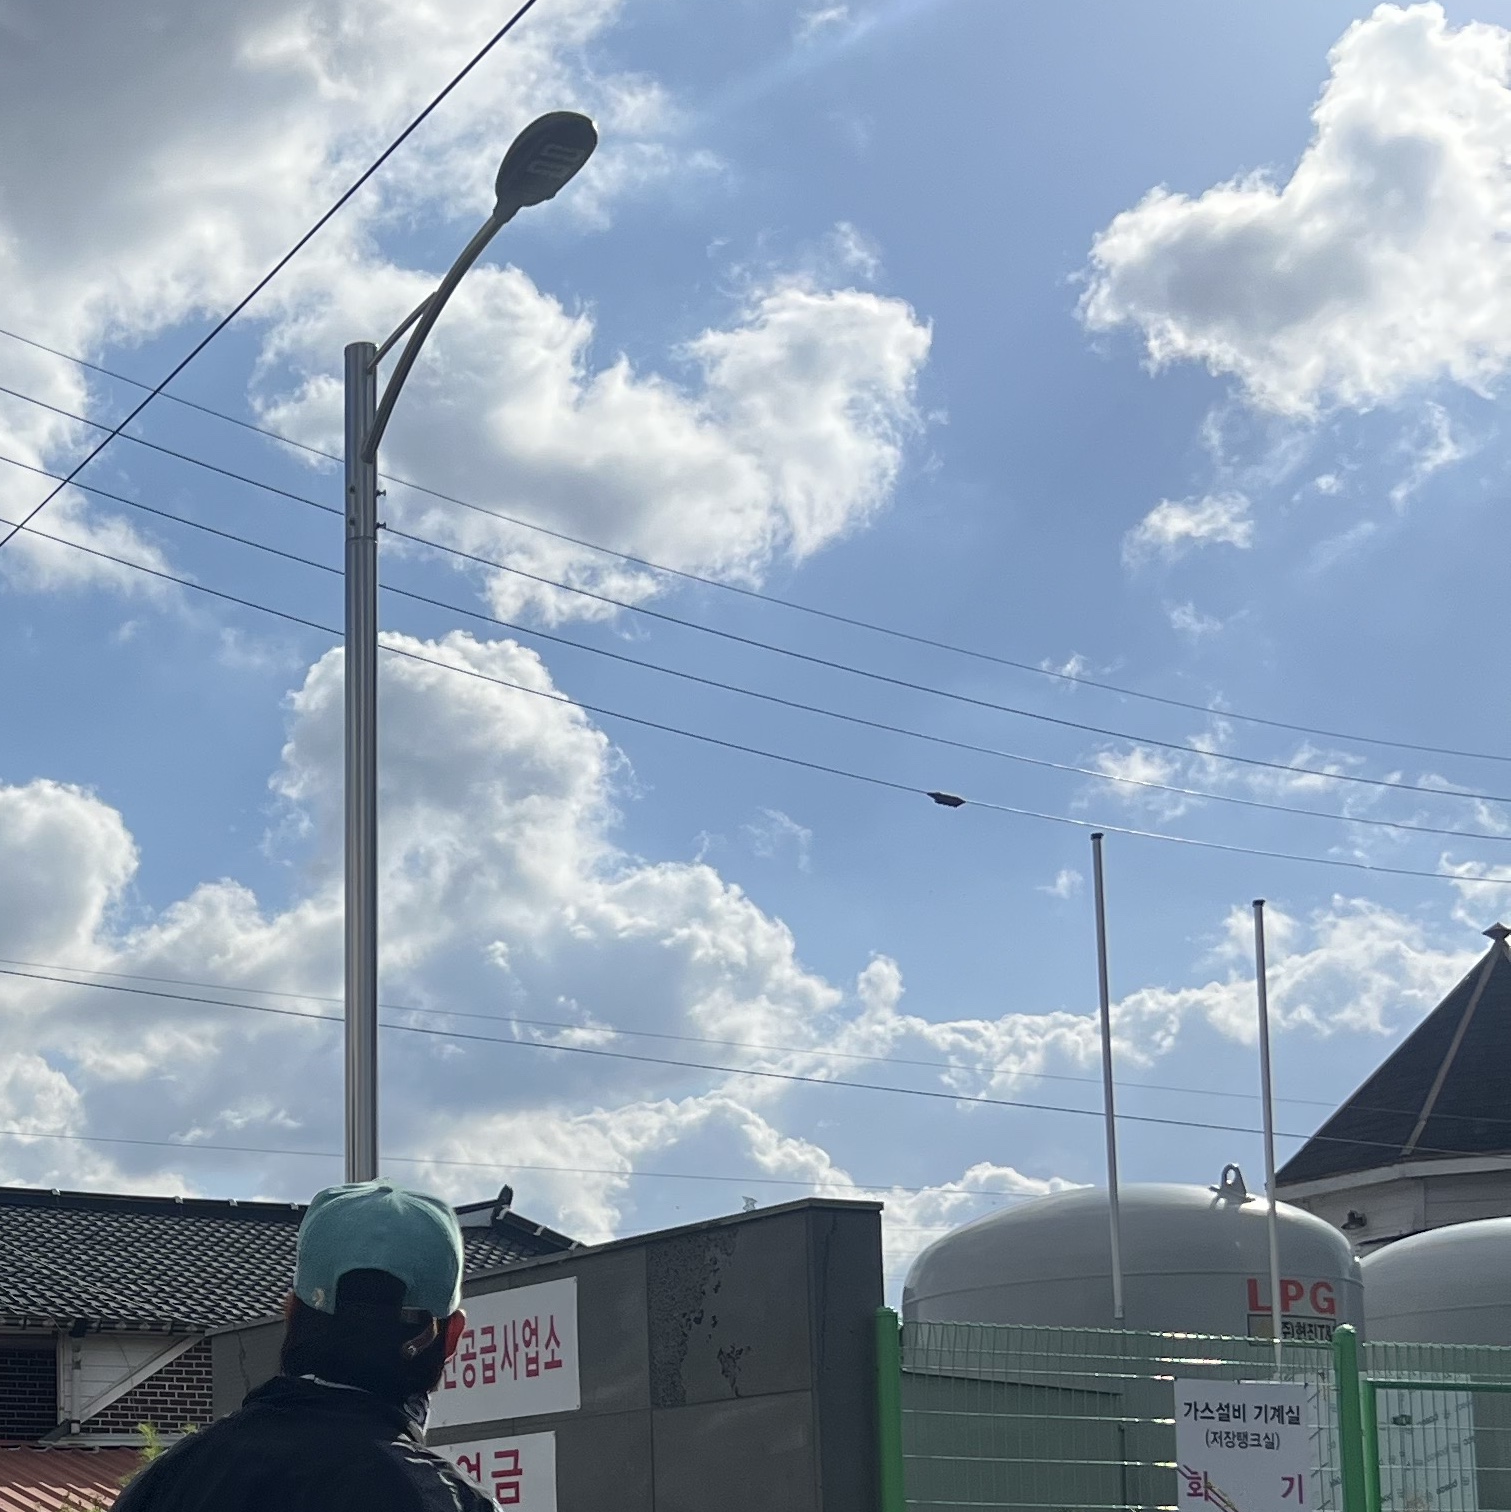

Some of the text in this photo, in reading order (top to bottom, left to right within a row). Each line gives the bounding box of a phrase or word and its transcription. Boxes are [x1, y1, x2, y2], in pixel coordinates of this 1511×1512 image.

[1246, 1278, 1337, 1315] LPG
[1183, 1401, 1301, 1426] 가스설비 기계실
[1205, 1428, 1281, 1451] (저장탱크실)
